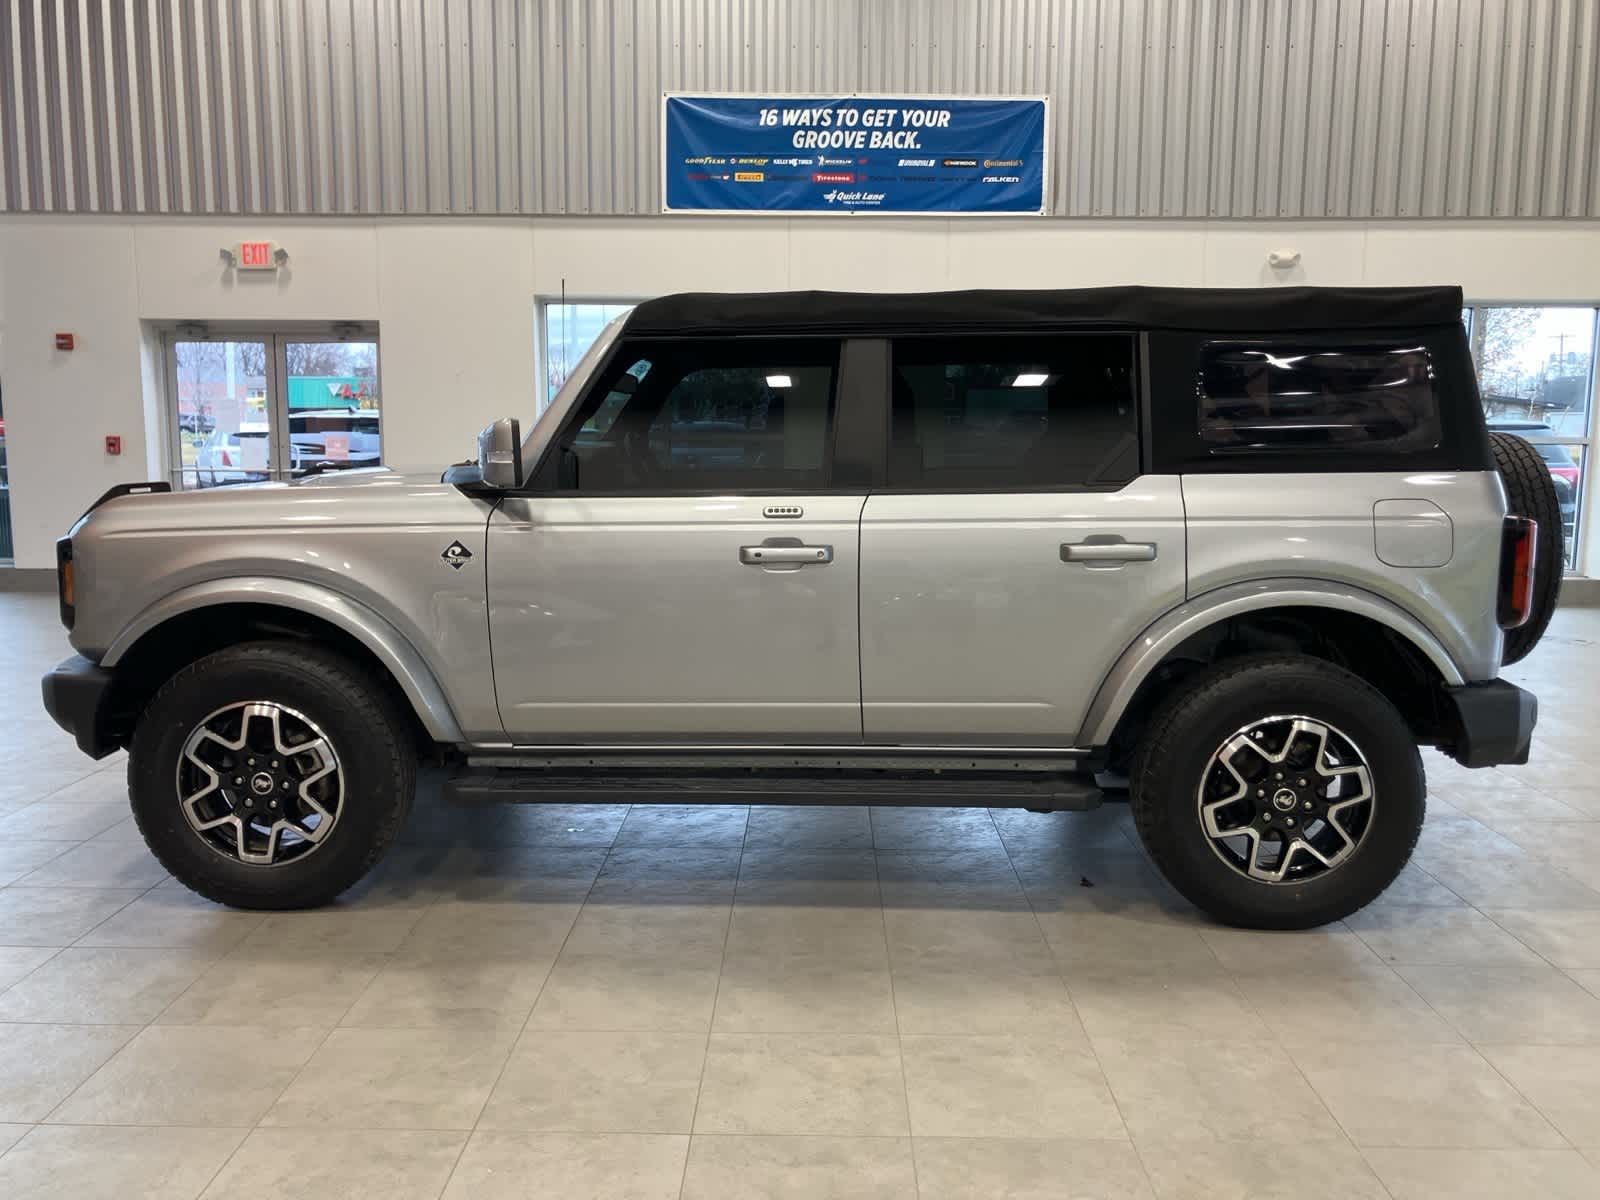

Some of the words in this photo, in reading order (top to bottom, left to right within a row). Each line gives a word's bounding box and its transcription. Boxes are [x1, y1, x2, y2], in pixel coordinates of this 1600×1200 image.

[759, 109, 778, 126] 16
[782, 109, 833, 127] WAYS
[837, 109, 859, 127] TO
[862, 109, 898, 127] GET
[901, 110, 950, 128] YOUR
[792, 130, 867, 149] GROOVE
[869, 131, 921, 149] BACK.
[837, 191, 861, 201] Quick
[862, 192, 885, 201] Lane
[241, 242, 270, 265] EXIT
